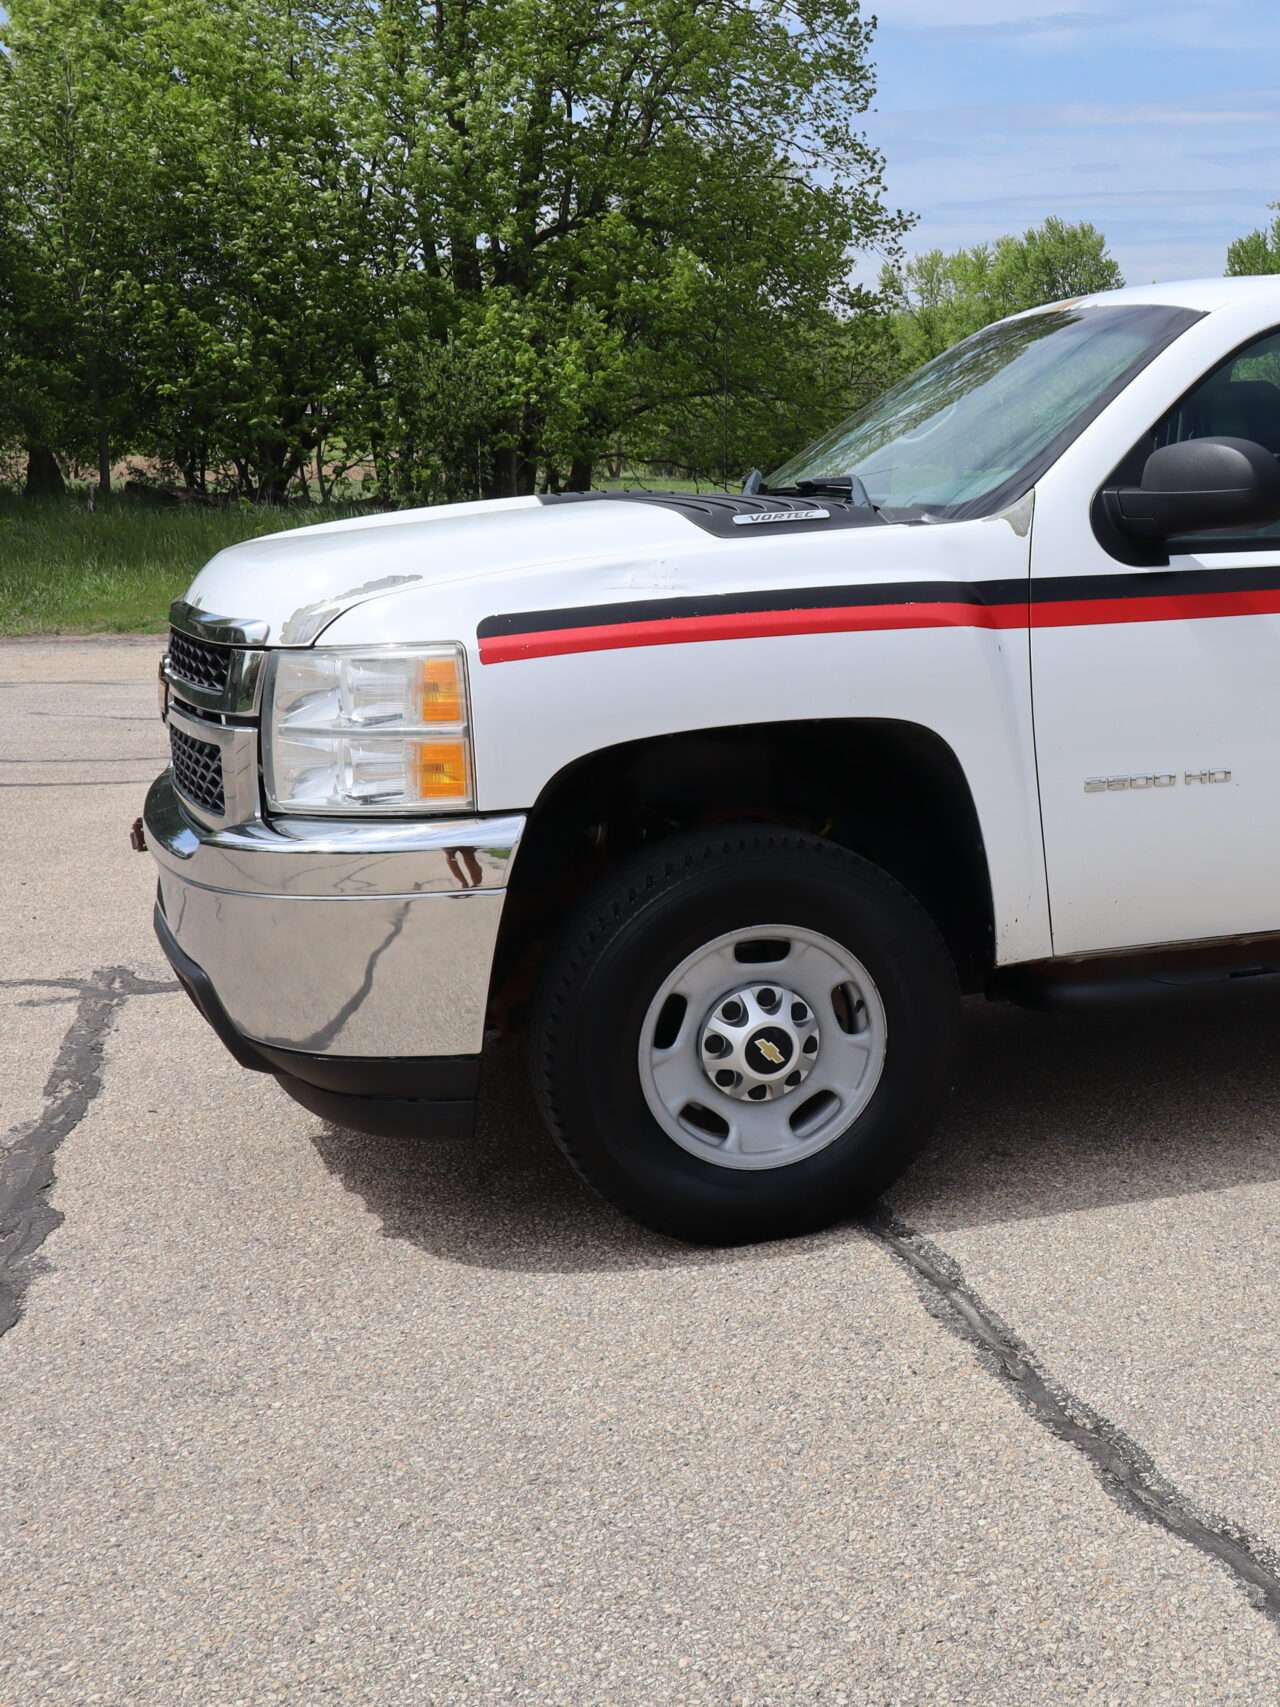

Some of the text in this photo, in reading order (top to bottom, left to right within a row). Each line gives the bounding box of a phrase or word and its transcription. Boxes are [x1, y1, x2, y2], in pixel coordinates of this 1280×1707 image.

[748, 511, 814, 522] VORTEC
[1084, 768, 1232, 793] 2500 HD
